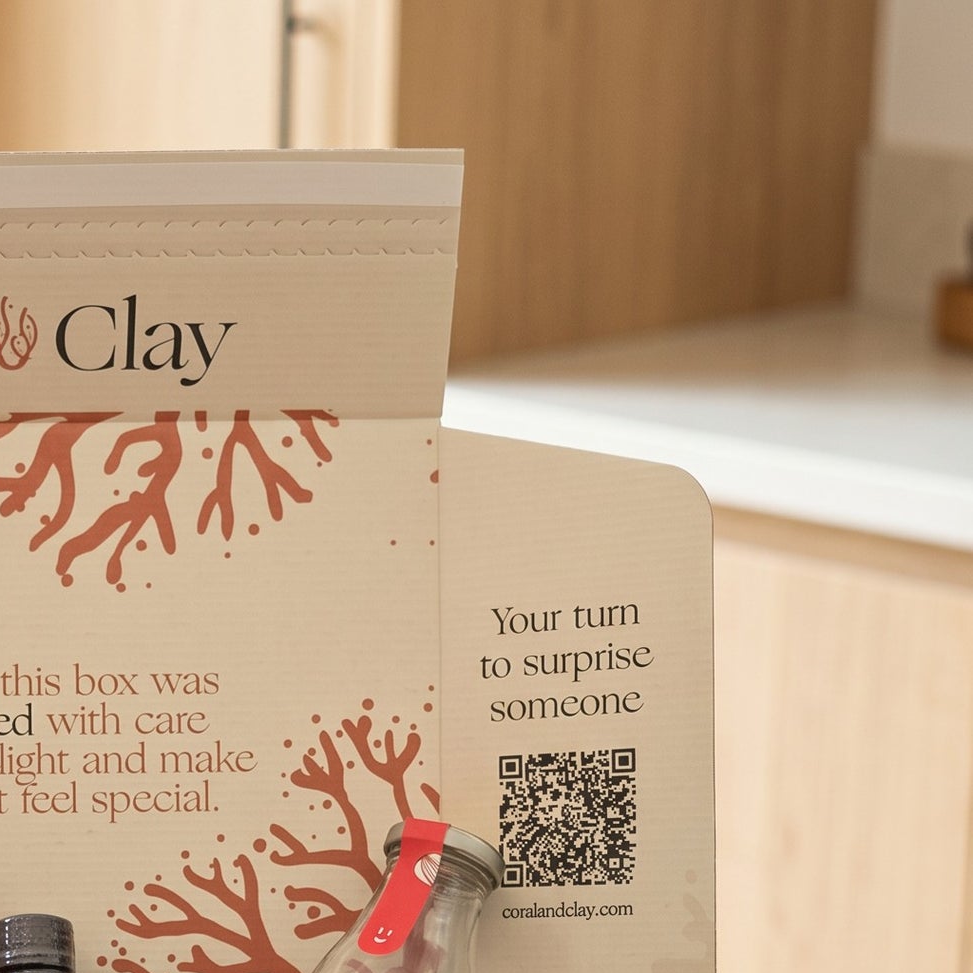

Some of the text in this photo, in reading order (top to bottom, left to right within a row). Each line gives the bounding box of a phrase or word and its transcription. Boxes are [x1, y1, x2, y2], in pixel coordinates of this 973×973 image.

[55, 294, 238, 387] Clay
[491, 603, 641, 635] Your turn
[480, 643, 655, 682] to surprise
[0, 665, 61, 697] this
[73, 664, 138, 696] box
[150, 671, 220, 696] was
[46, 702, 121, 735] with
[134, 709, 210, 735] care
[490, 690, 644, 722] someone
[82, 742, 146, 774] and
[160, 741, 258, 773] make
[21, 781, 78, 814] feel
[92, 781, 219, 823] special.
[502, 901, 634, 921] coralandclay.com
